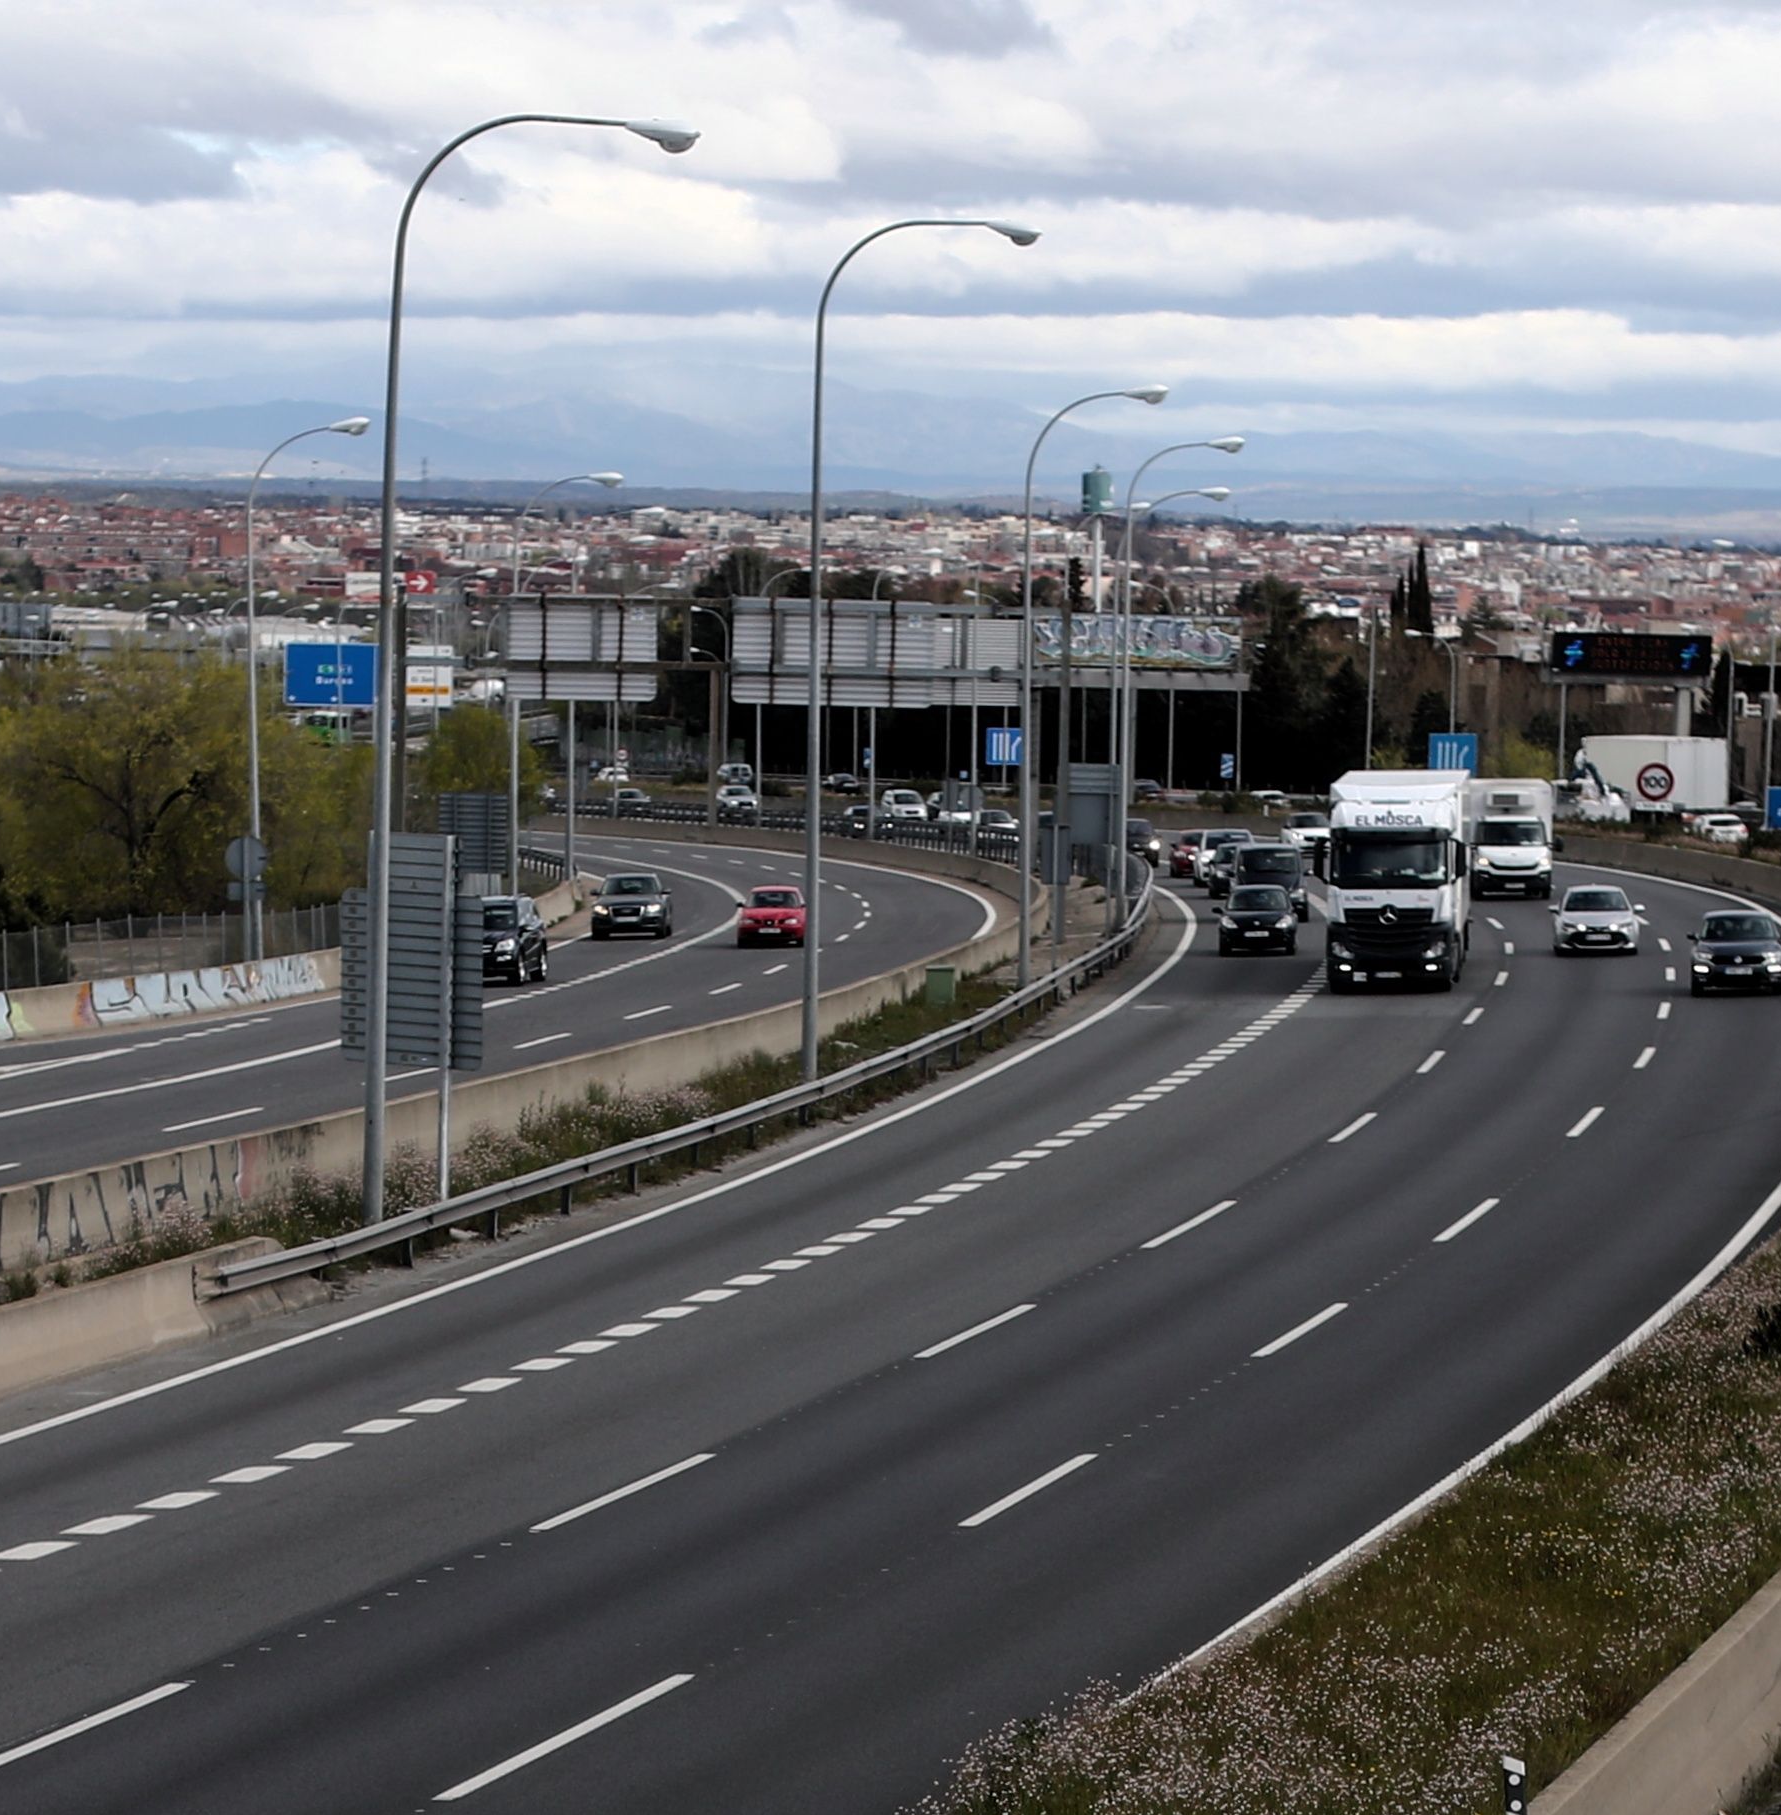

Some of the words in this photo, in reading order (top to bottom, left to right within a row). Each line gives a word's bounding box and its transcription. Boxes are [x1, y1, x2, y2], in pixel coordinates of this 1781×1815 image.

[1644, 777, 1667, 788] 100
[1355, 815, 1371, 826] EL
[1375, 812, 1423, 826] MOSCA
